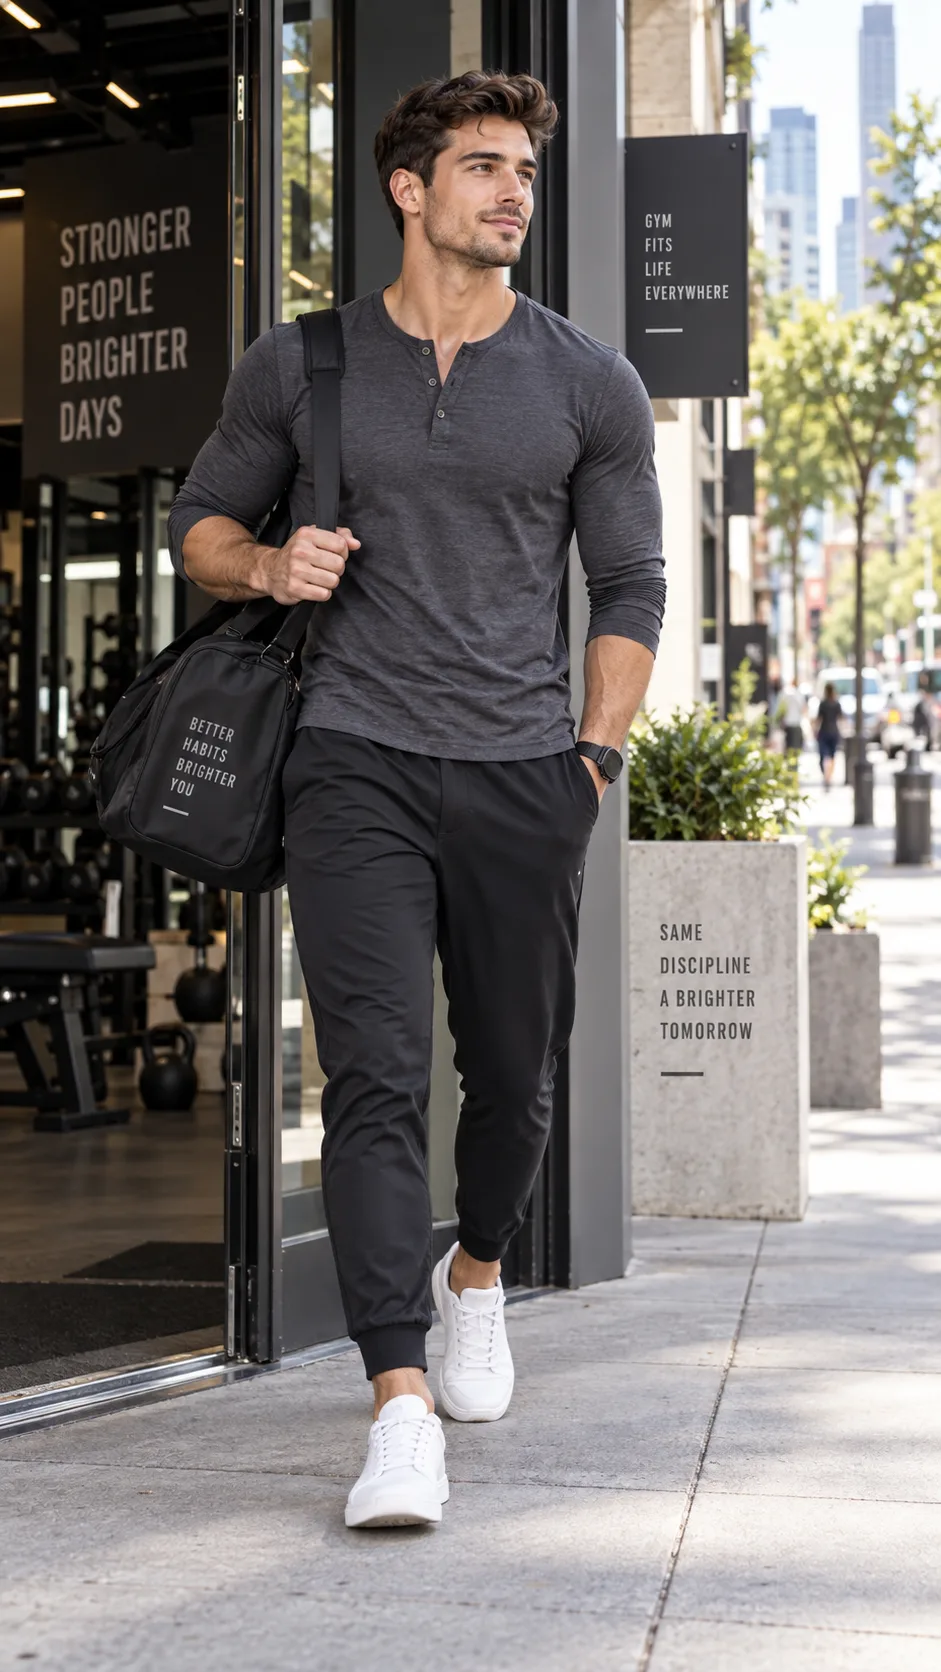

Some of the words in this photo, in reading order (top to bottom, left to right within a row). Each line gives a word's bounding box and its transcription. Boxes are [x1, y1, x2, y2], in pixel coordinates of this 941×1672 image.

[645, 213, 671, 228] GYM
[60, 205, 191, 267] STRONGER
[645, 237, 672, 252] FITS
[645, 261, 671, 276] LIFE
[60, 271, 153, 325] PEOPLE
[645, 284, 729, 300] EVERYWHERE
[60, 327, 187, 383] BRIGHTER
[60, 395, 122, 442] DAYS
[189, 716, 234, 742] BETTER
[182, 736, 227, 762] HABITS
[175, 757, 236, 788] BRIGHTER
[170, 777, 194, 796] YOU
[660, 923, 702, 940] SAME
[660, 956, 751, 973] DISCIPLINE
[660, 989, 668, 1006] A
[676, 989, 755, 1006] BRIGHTER
[660, 1022, 752, 1039] TOMORROW
